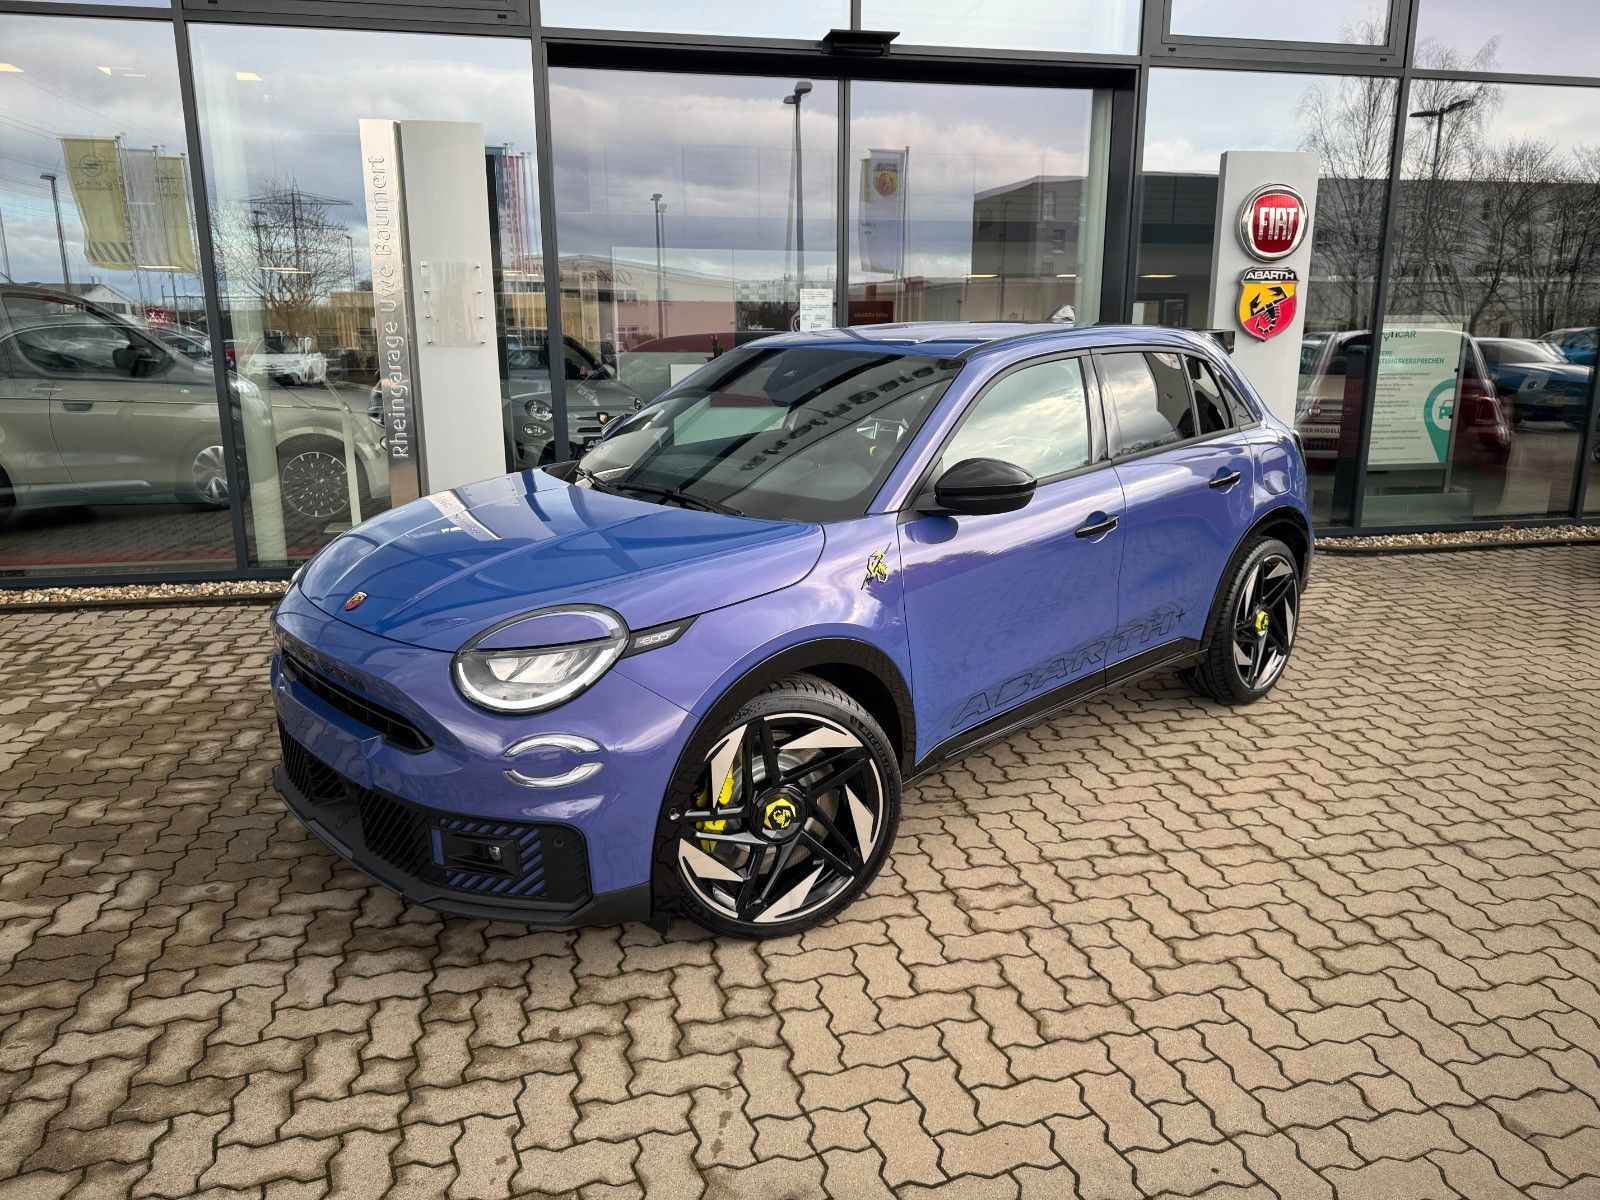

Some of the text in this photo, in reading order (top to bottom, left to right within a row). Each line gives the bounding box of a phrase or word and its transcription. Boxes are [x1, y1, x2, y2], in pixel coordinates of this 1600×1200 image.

[1257, 206, 1298, 241] FIAT
[1245, 271, 1295, 280] ABARTH
[367, 155, 409, 459] Rheingarage Uwe Baumert
